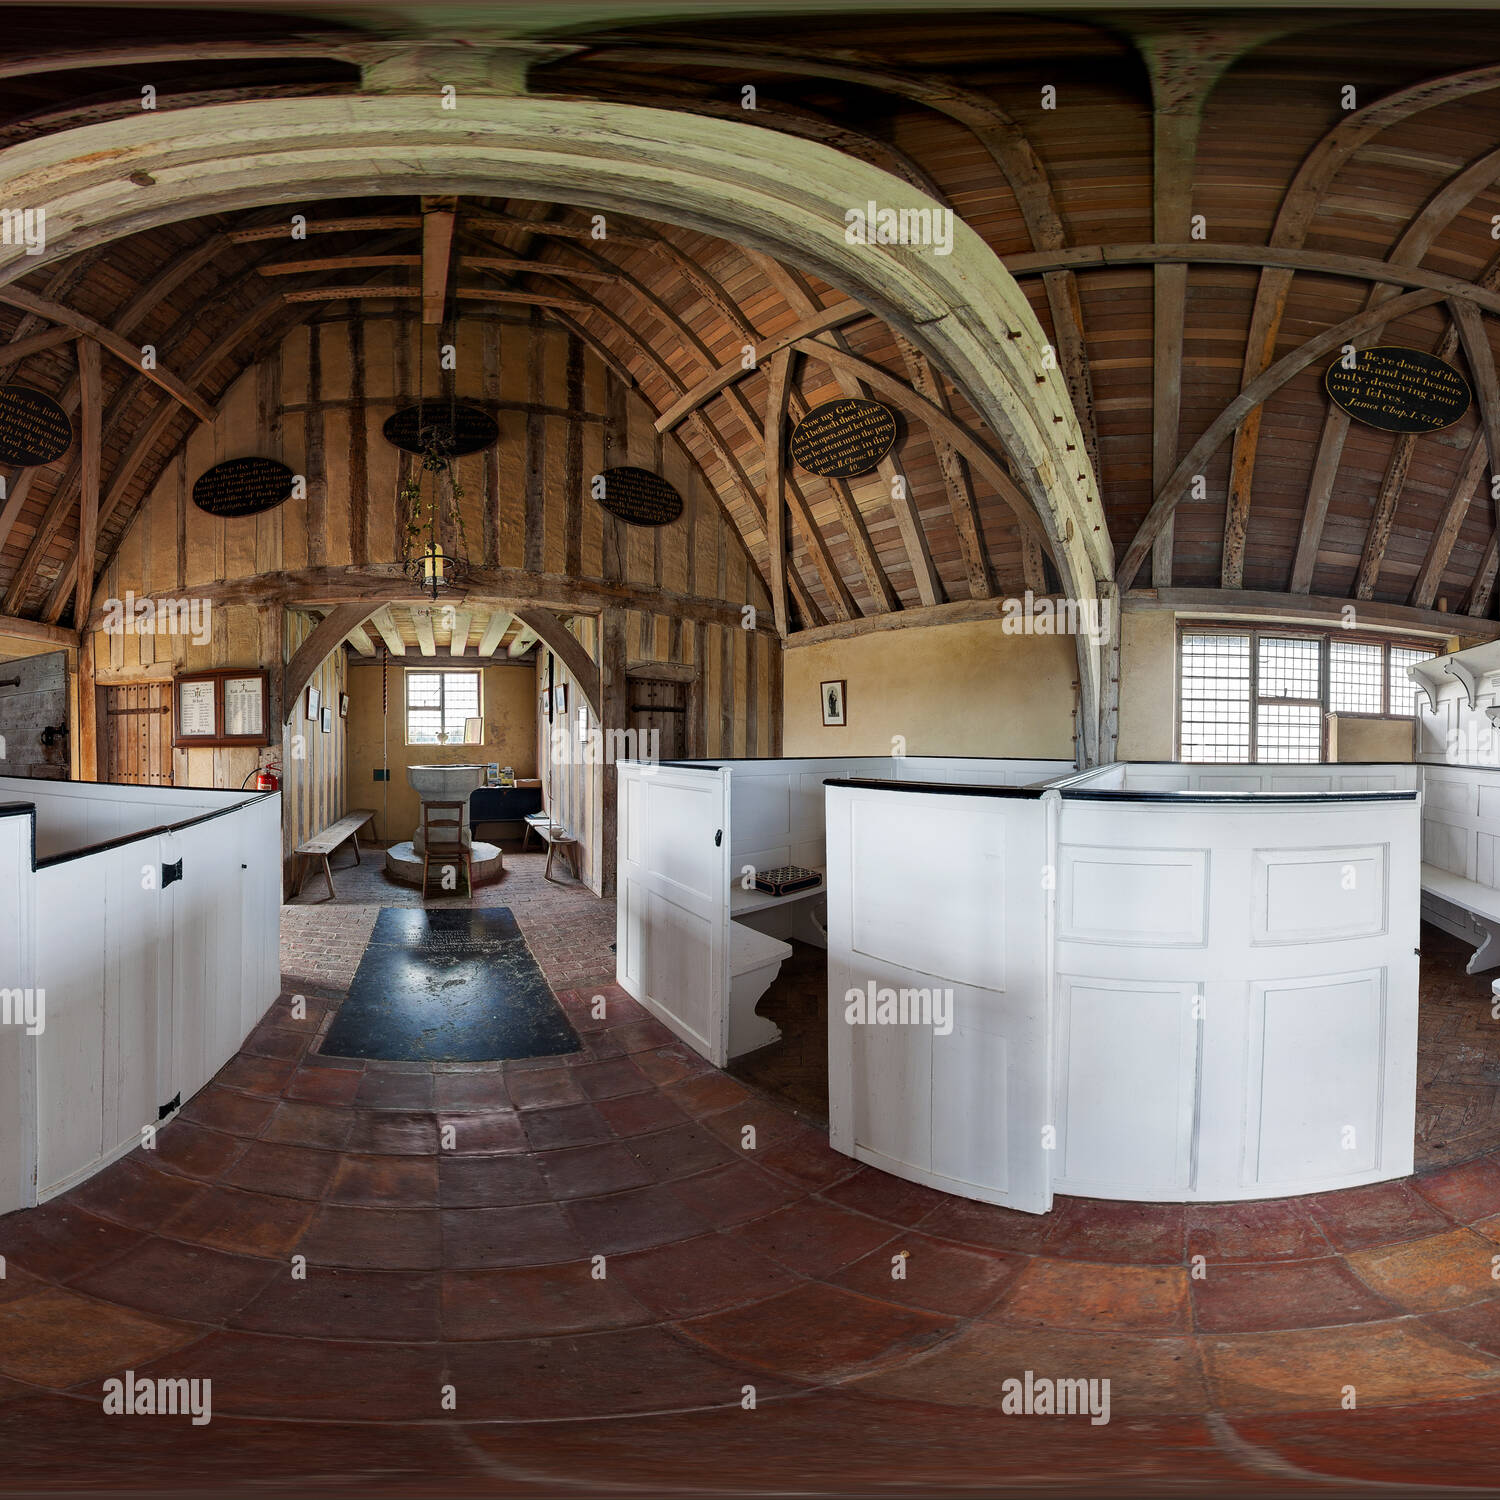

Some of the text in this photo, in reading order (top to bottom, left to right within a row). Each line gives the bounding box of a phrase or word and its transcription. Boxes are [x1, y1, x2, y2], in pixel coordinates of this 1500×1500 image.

[1364, 352, 1379, 360] Be
[1396, 360, 1428, 374] doers
[1430, 370, 1444, 378] of
[1444, 372, 1460, 382] the
[1333, 384, 1360, 394] own
[1370, 377, 1428, 399] deceiving
[1430, 393, 1458, 406] your
[1374, 368, 1398, 378] and
[1401, 374, 1421, 384] not
[1423, 377, 1462, 396] hearers
[820, 412, 834, 421] my
[836, 401, 856, 414] God
[1344, 398, 1378, 410] James
